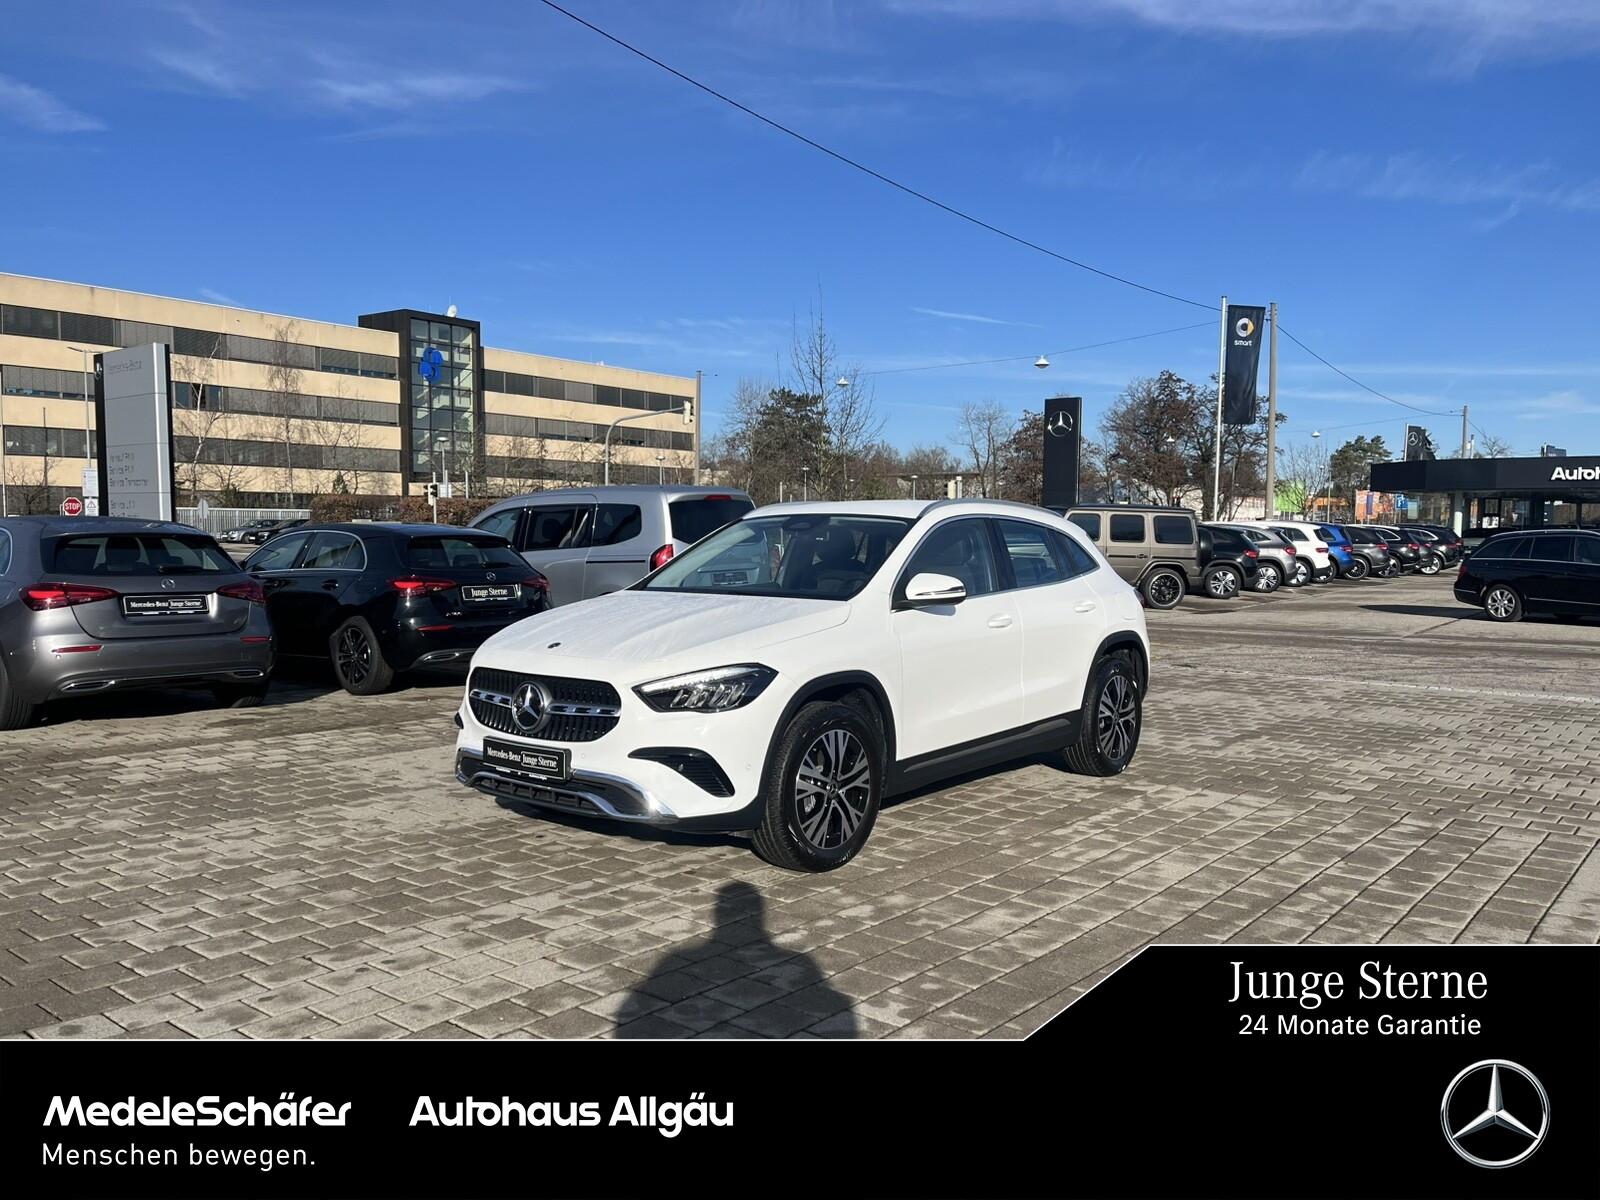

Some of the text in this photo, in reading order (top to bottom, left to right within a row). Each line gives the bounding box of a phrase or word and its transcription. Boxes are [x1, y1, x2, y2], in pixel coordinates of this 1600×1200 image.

[471, 587, 507, 597] Junge Sterne
[130, 600, 168, 608] Mercedes-Benz
[487, 746, 557, 768] Mercedes-Benz Junge Sterne
